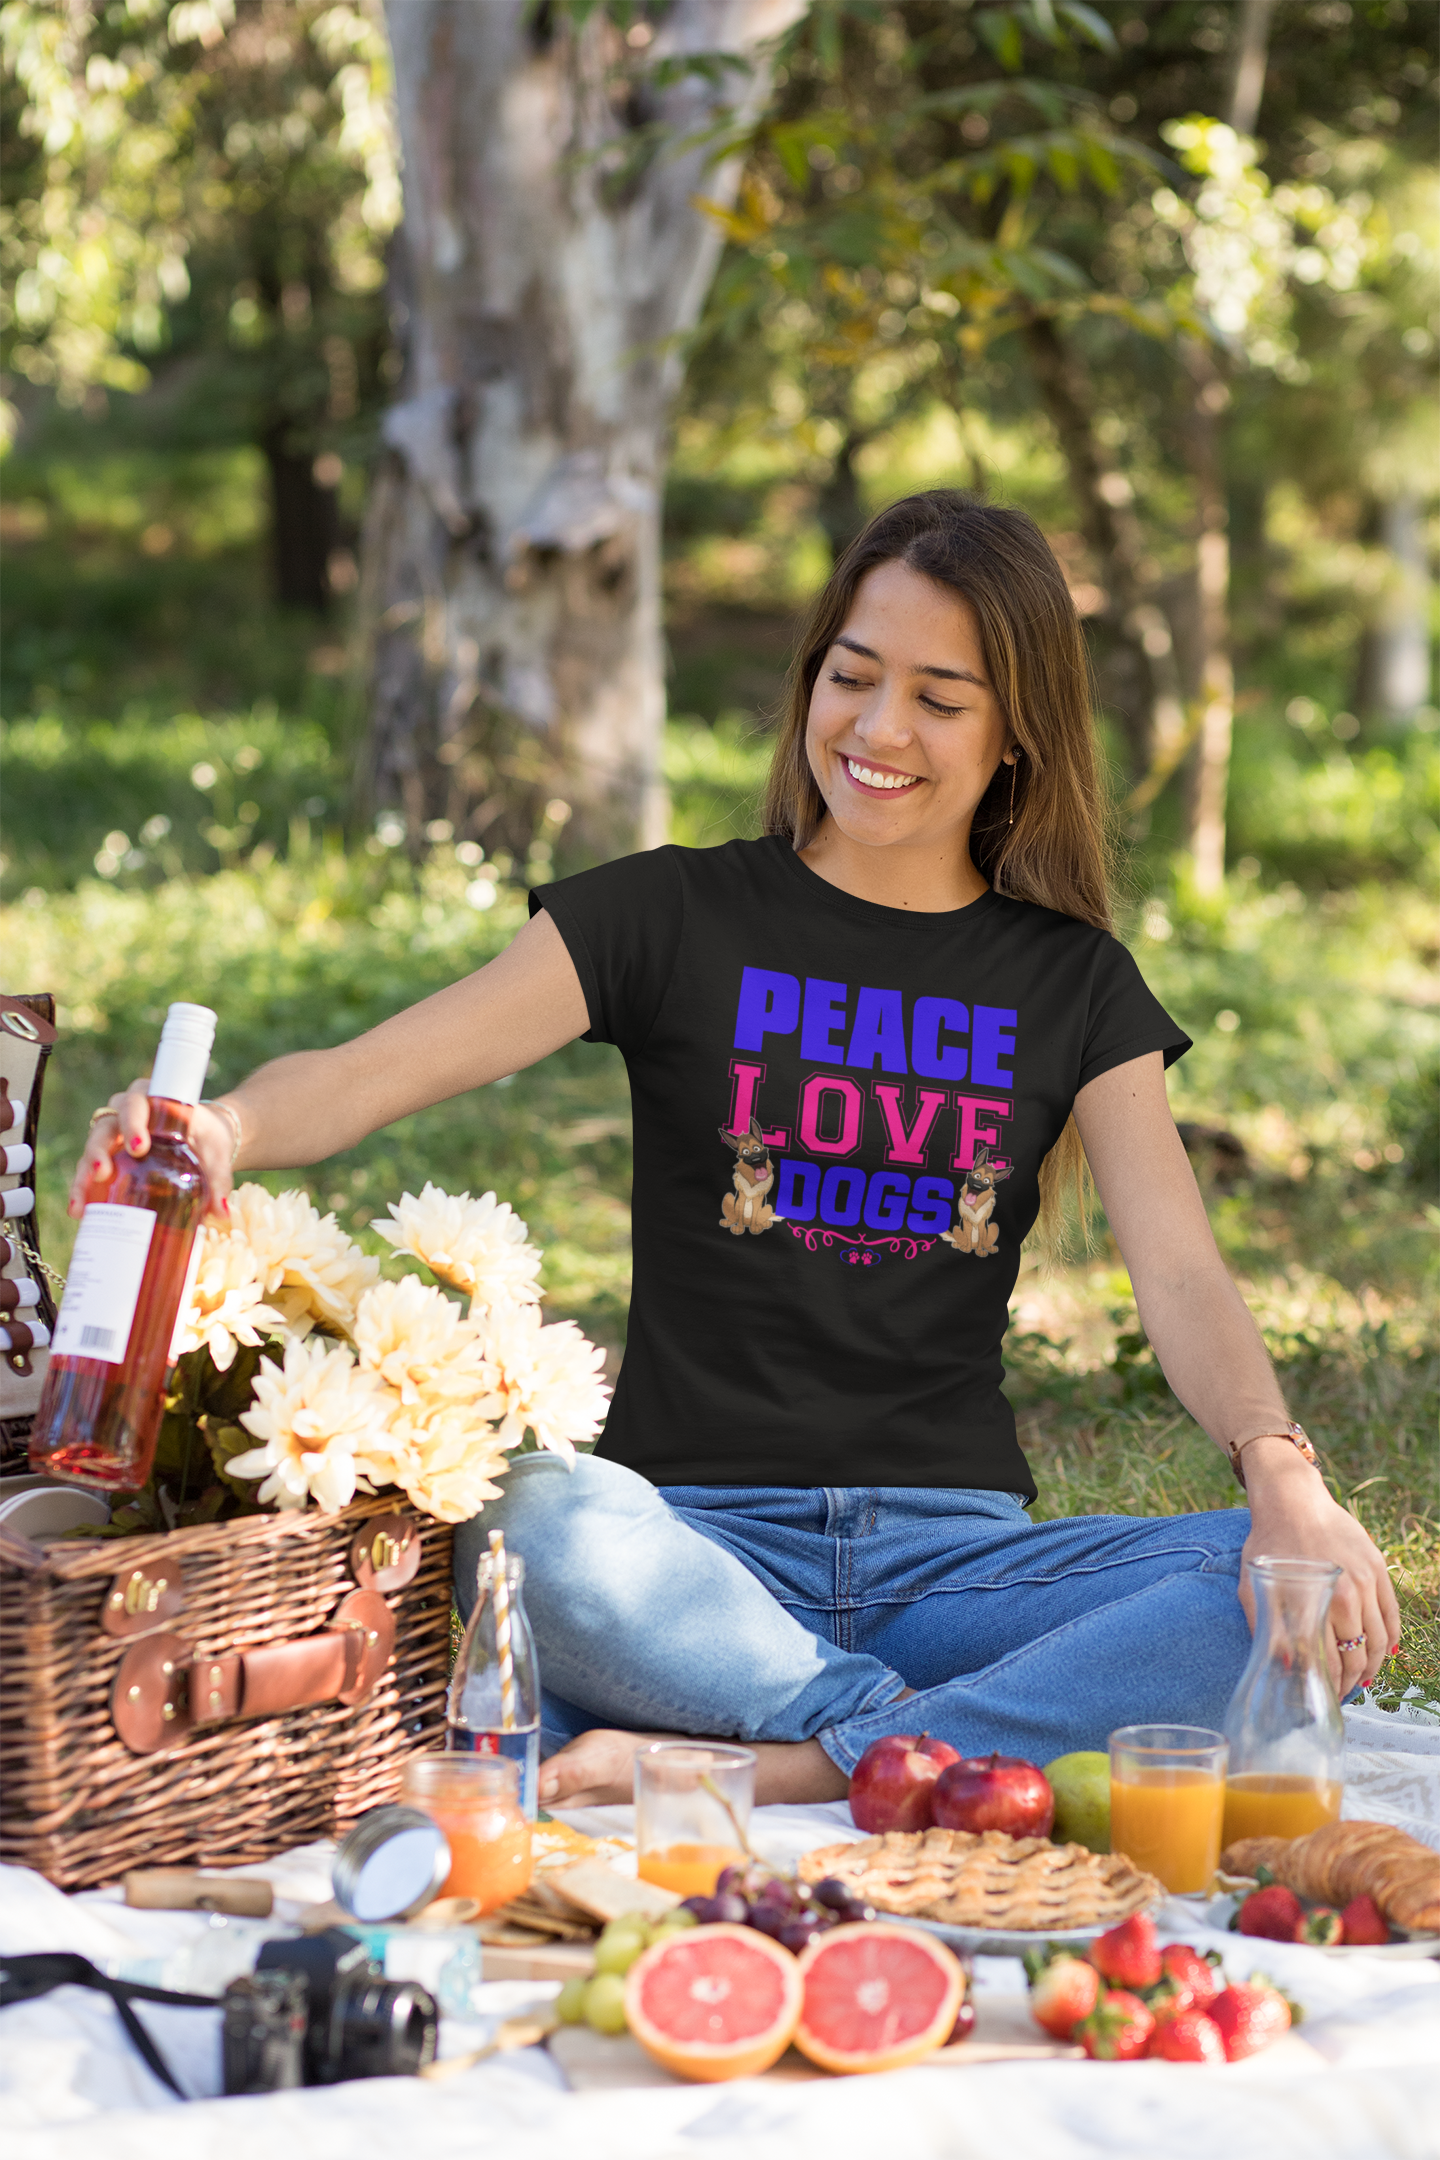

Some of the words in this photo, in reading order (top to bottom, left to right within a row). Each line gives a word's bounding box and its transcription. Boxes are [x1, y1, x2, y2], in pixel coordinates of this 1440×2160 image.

[733, 966, 1018, 1089] PEACE
[721, 1058, 1014, 1179] LOVE
[775, 1158, 955, 1234] DOGS
